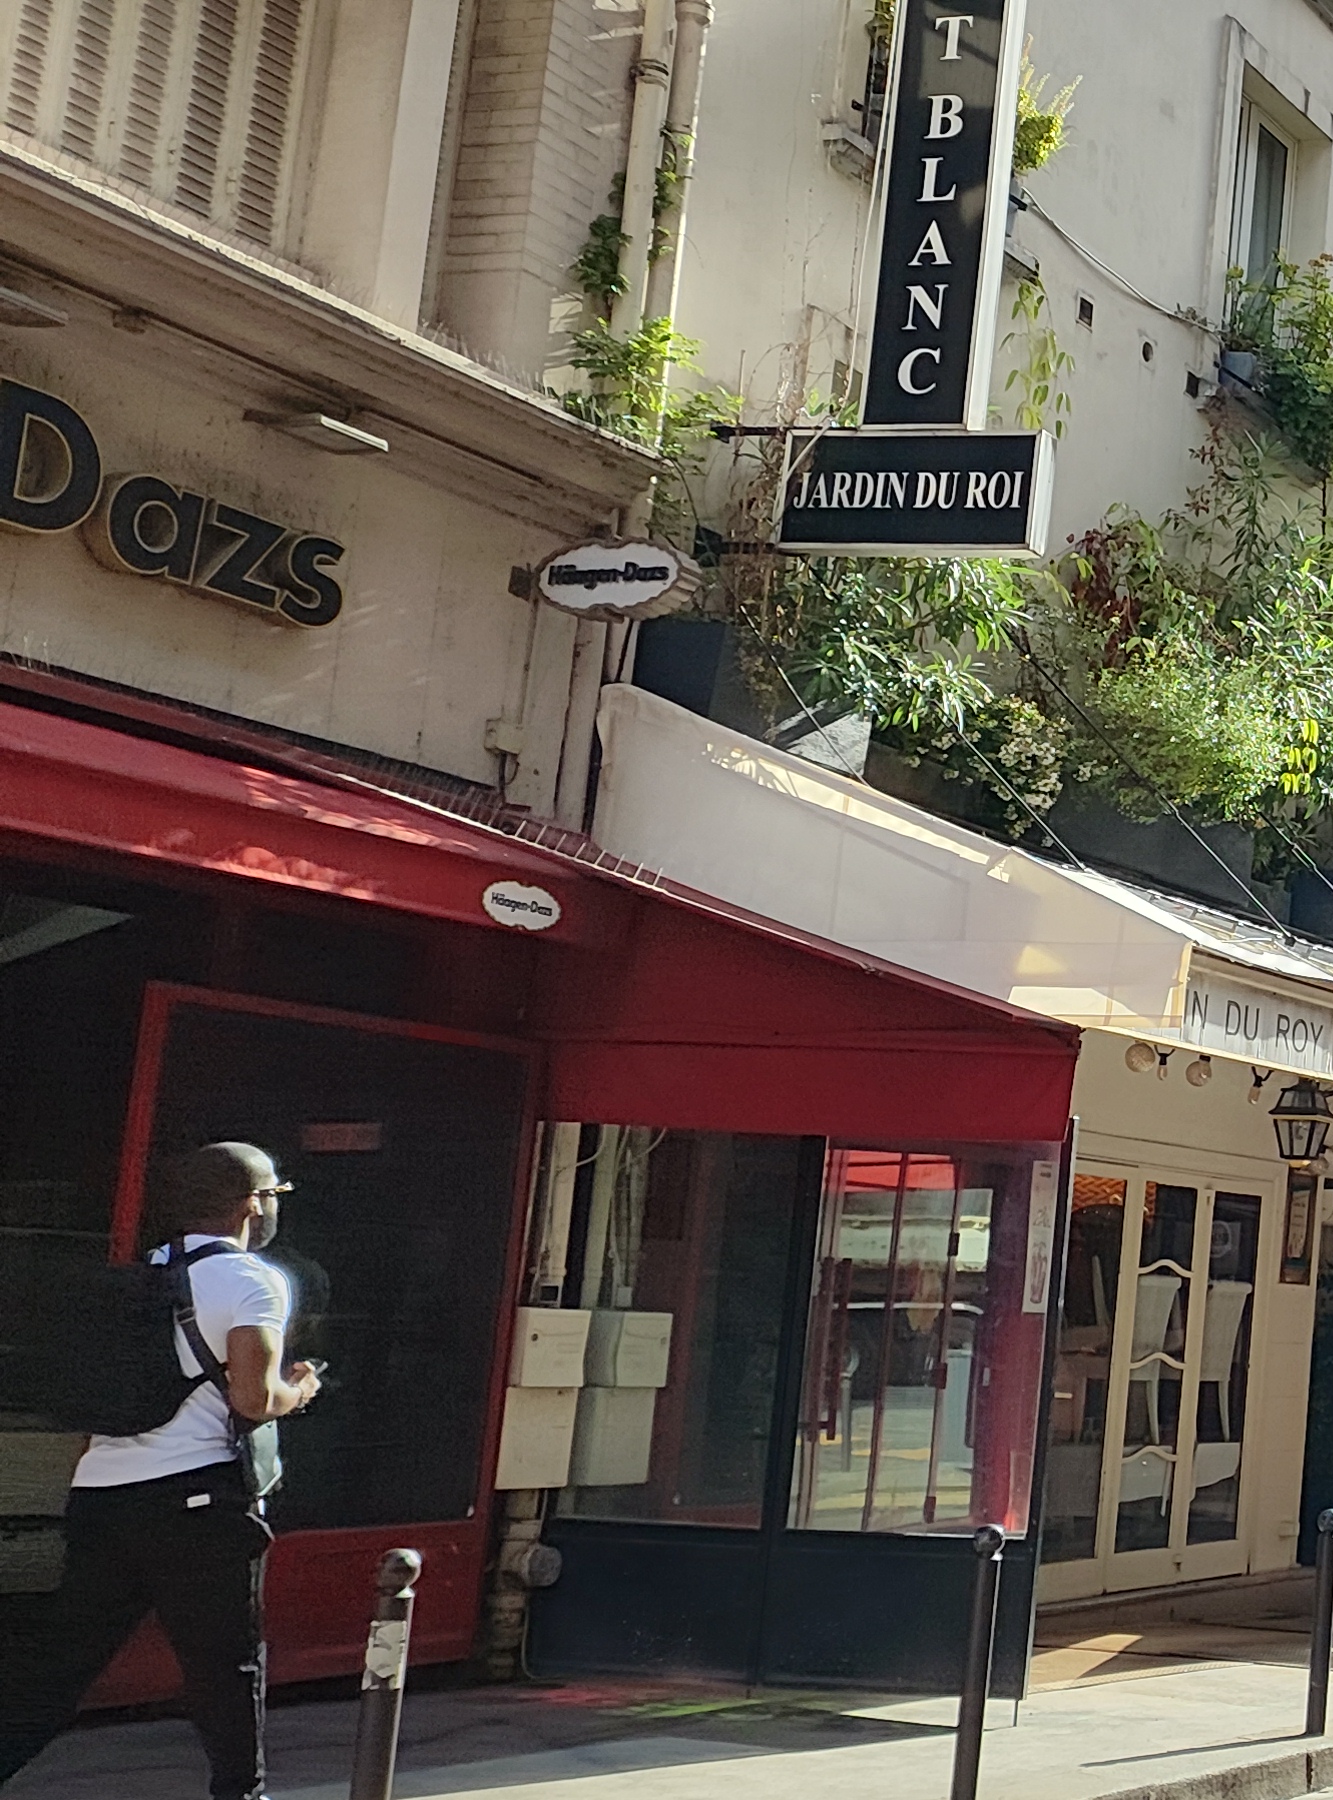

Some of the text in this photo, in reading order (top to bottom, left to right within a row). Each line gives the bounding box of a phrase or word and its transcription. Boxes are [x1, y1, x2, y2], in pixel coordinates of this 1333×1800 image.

[897, 93, 965, 396] BLANC
[793, 471, 1025, 510] JARDIN DU ROI
[1226, 1000, 1261, 1041] DU
[1275, 1014, 1324, 1056] ROY
